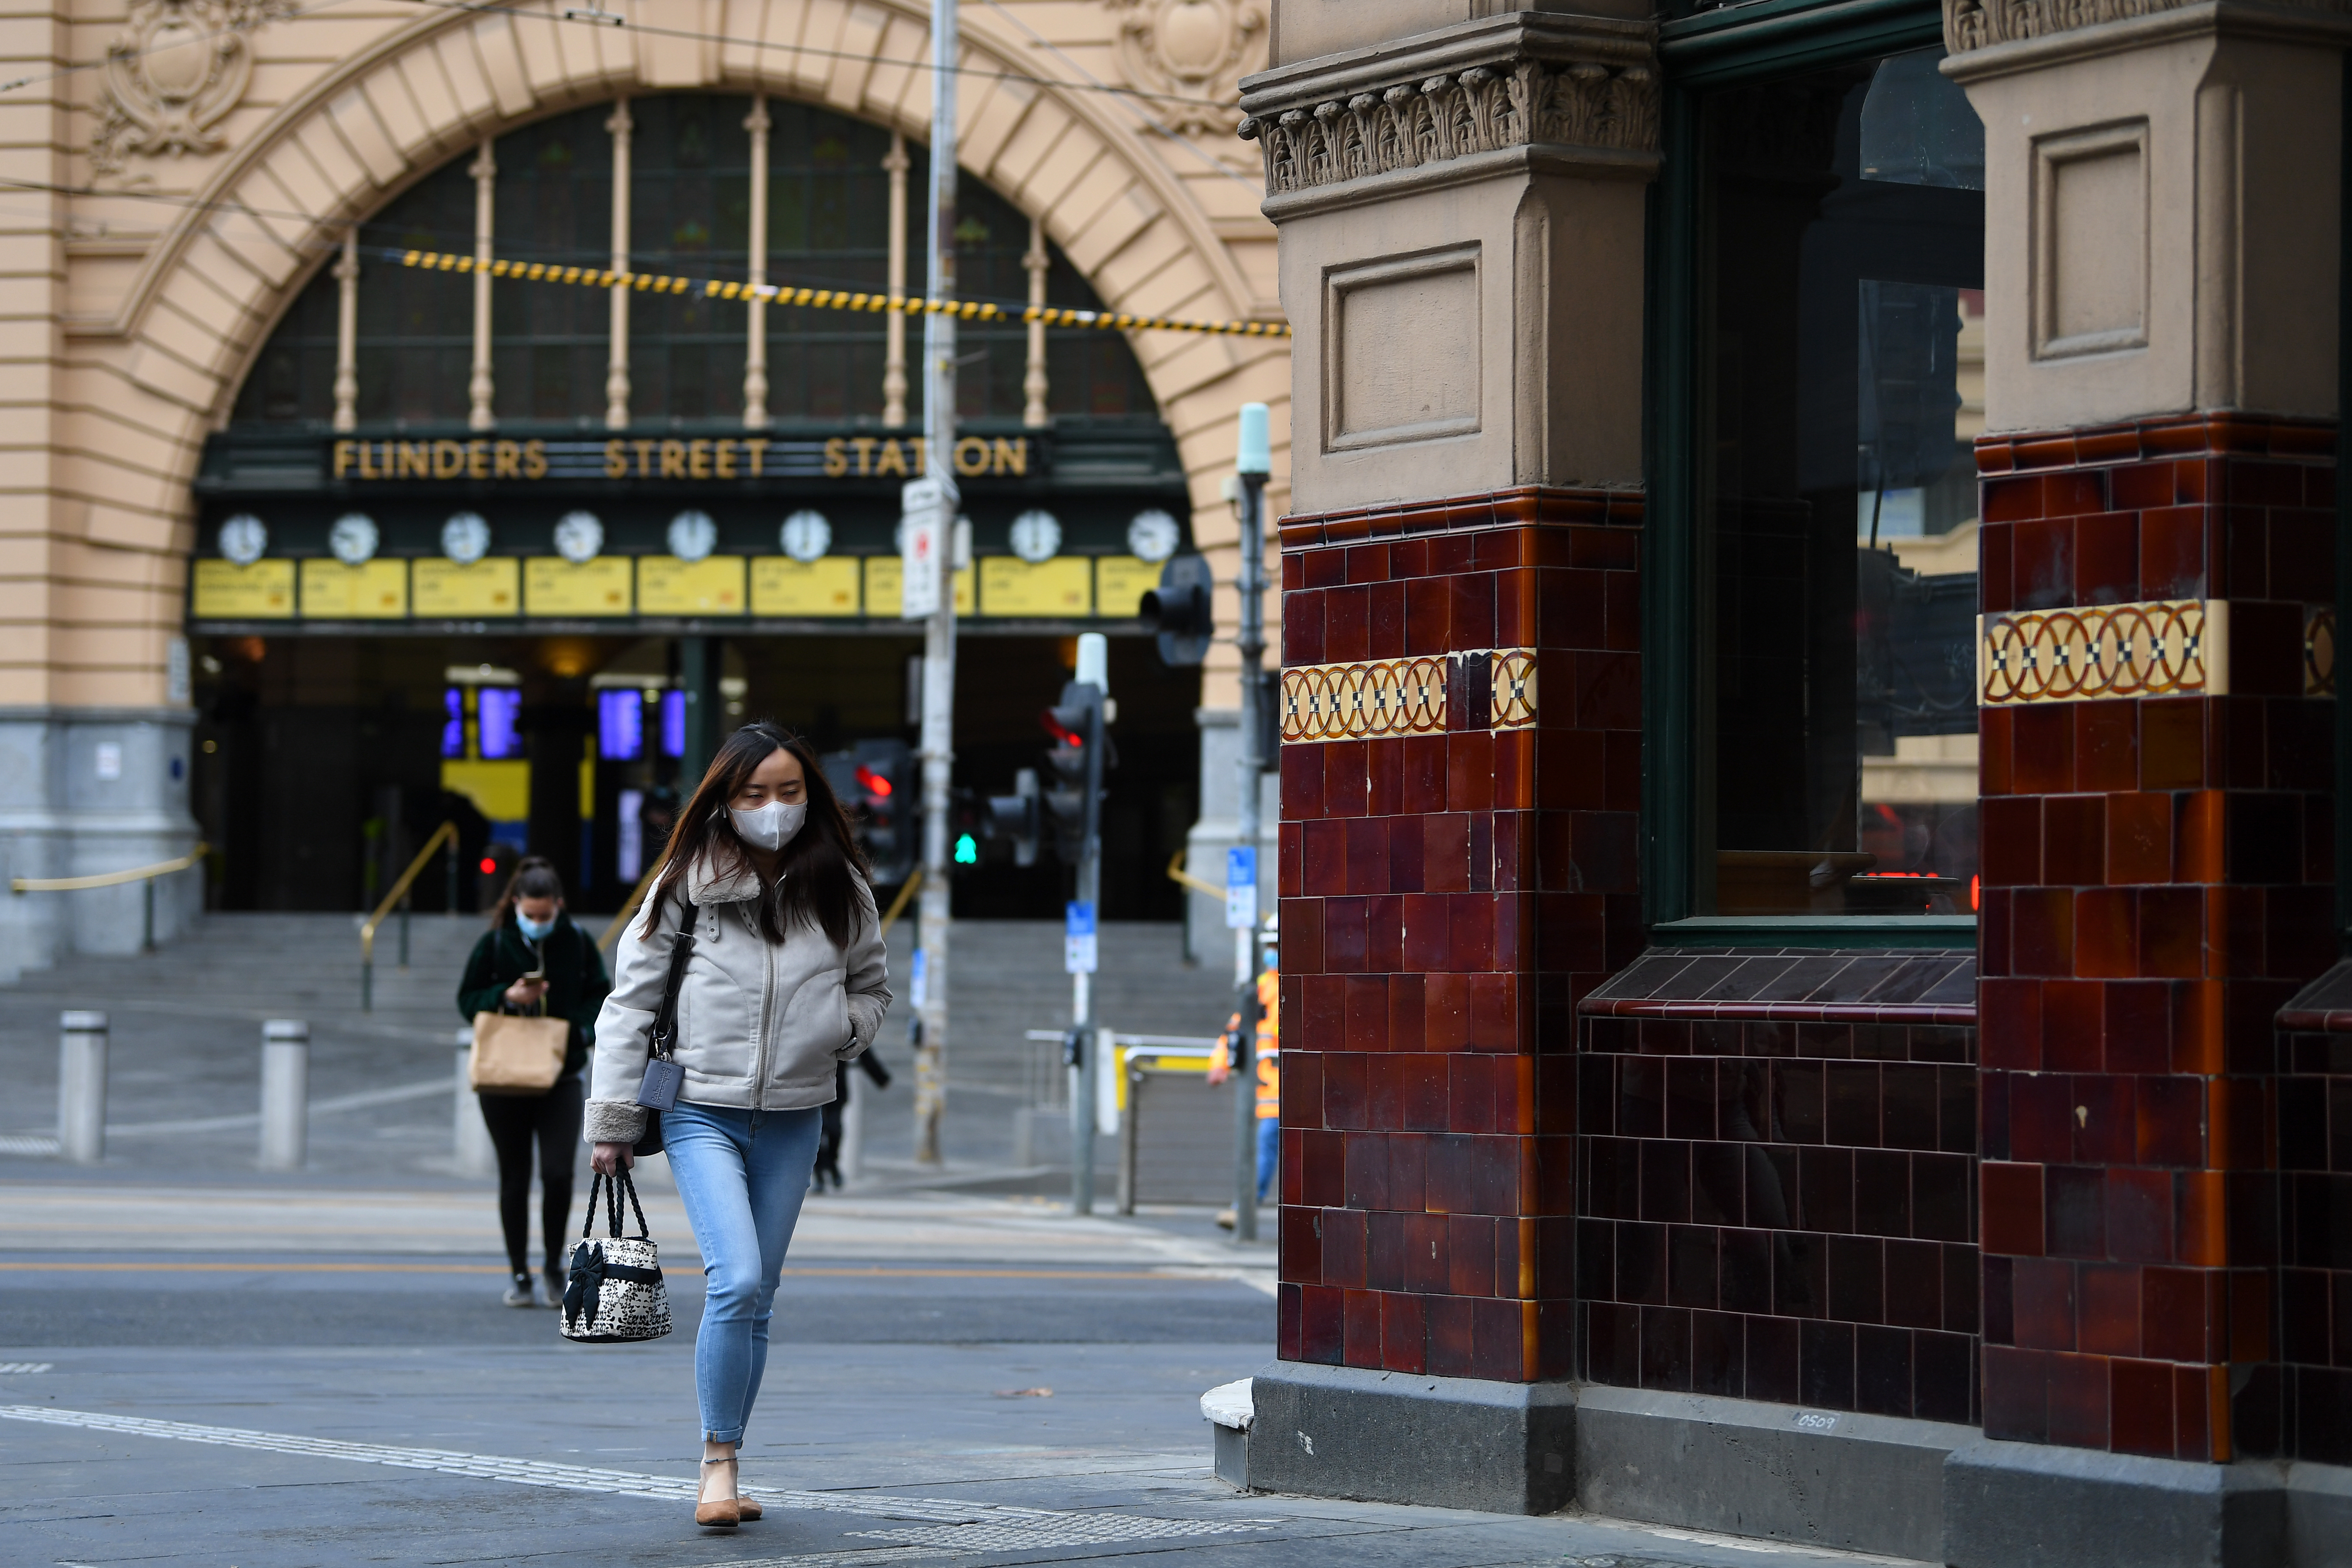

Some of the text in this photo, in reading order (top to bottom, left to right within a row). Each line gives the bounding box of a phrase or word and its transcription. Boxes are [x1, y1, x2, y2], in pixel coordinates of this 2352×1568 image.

[334, 437, 1026, 479] FLINDERS STREET STATON
[1798, 1415, 1835, 1429] 0509
